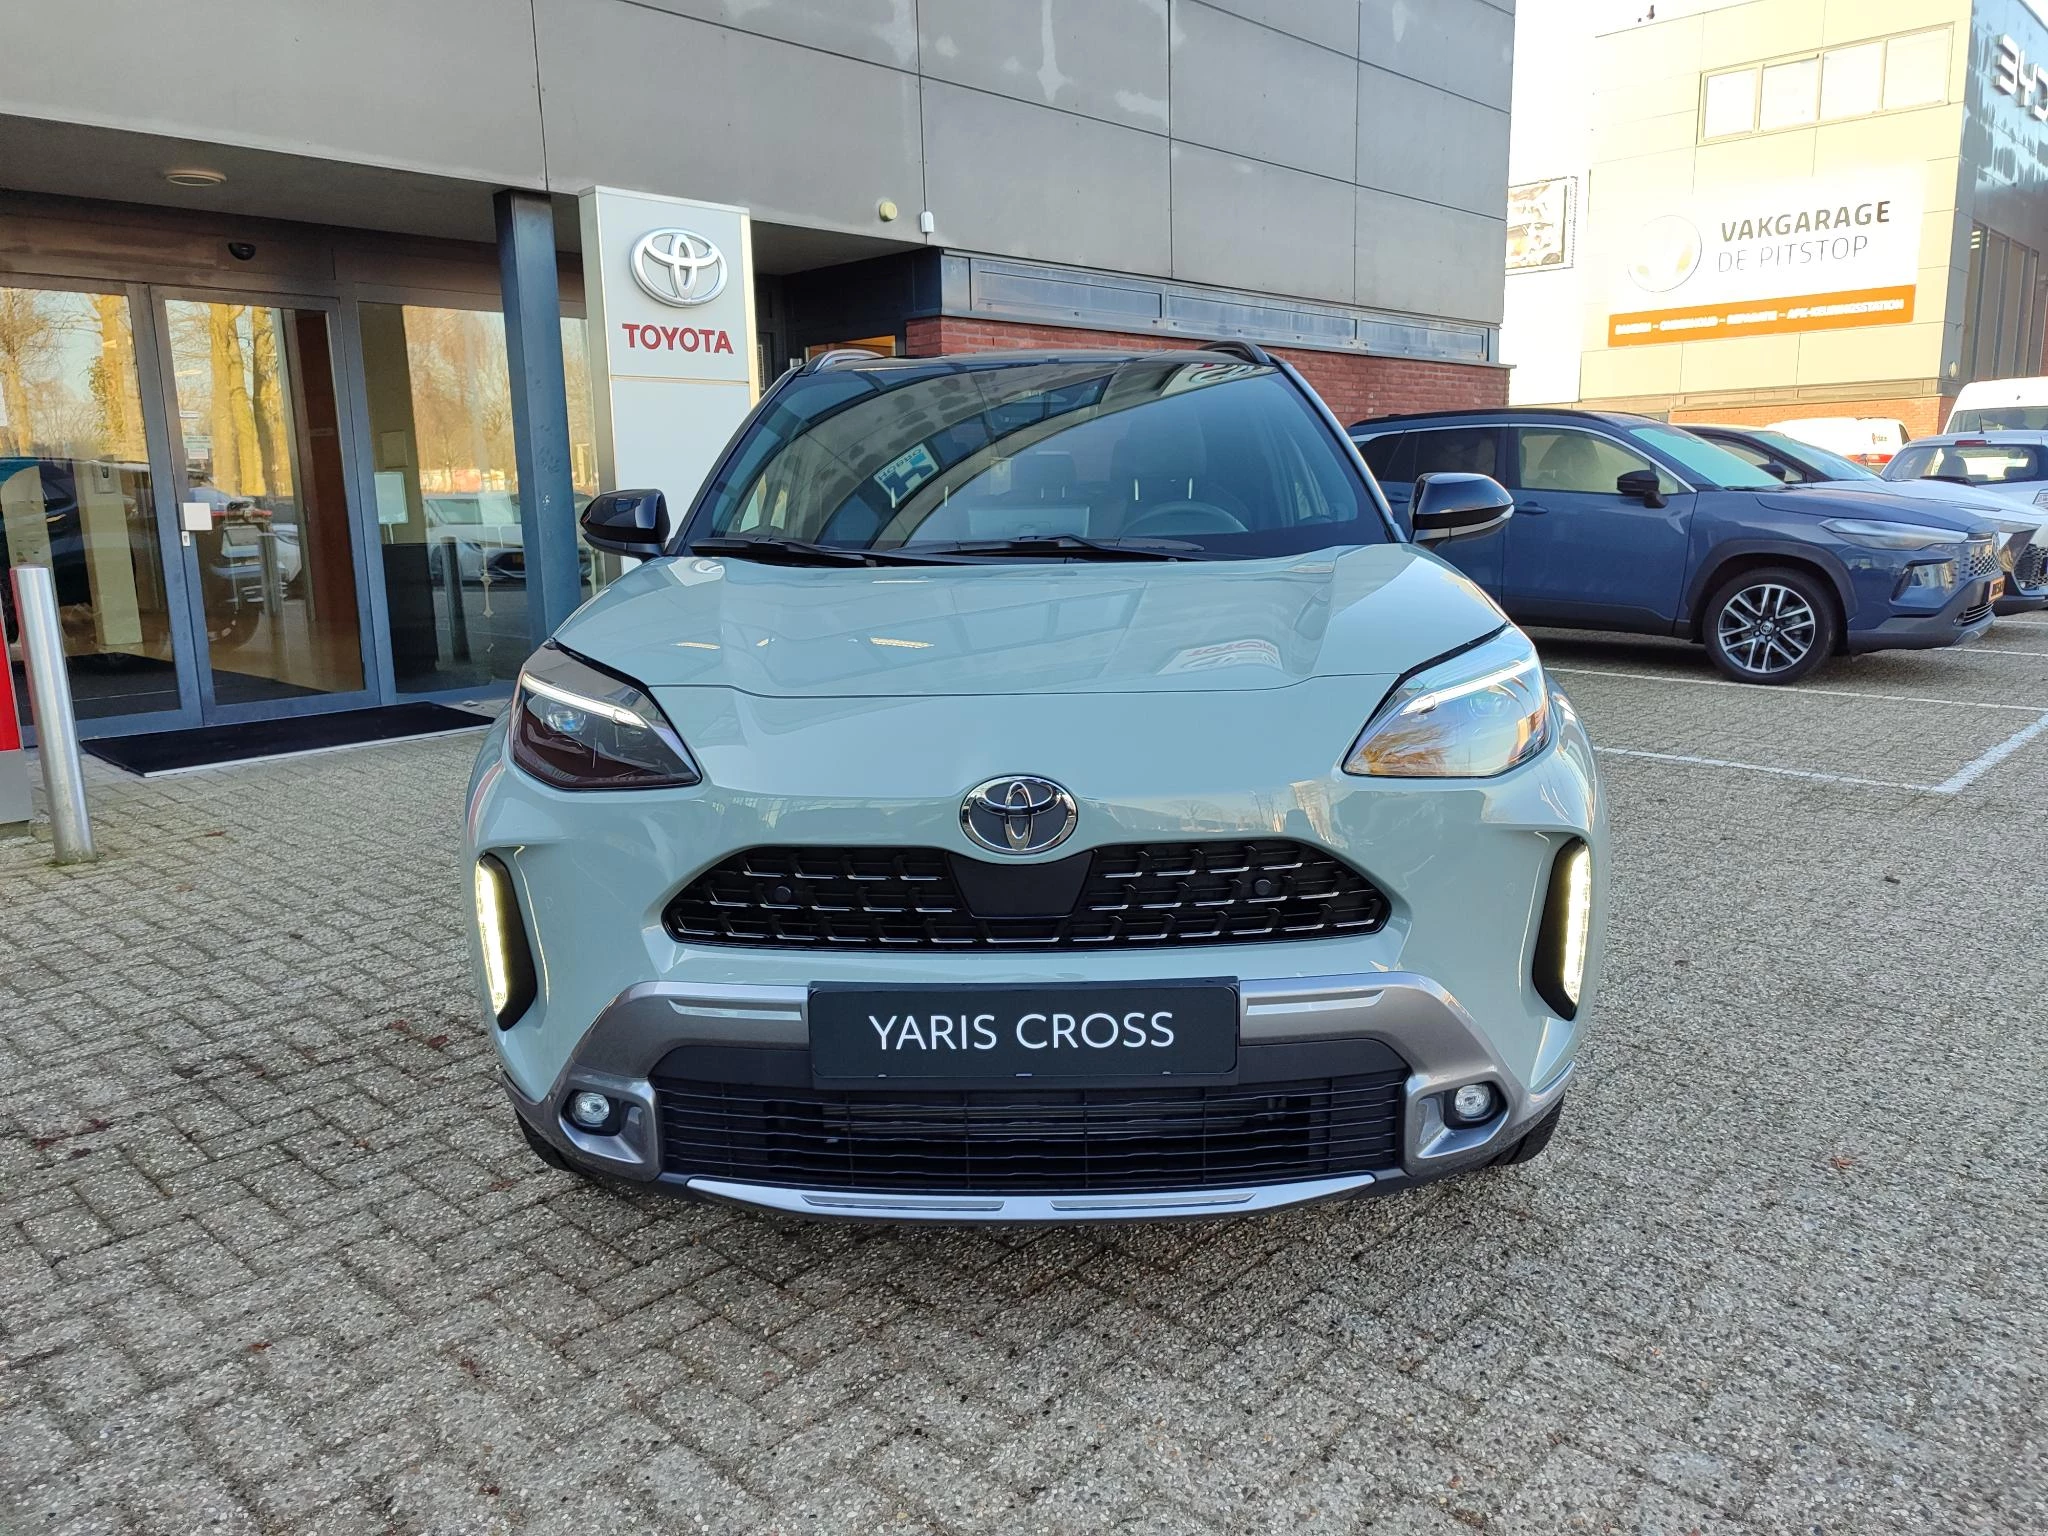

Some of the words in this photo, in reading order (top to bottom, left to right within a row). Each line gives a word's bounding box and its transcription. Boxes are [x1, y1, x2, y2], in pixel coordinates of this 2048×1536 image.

[1721, 200, 1891, 242] VAKGARAGE
[1718, 249, 1749, 273] DE
[1759, 235, 1868, 268] PITSTOP
[621, 323, 735, 355] TOYOTA
[868, 1014, 997, 1050] YARIS
[1016, 1011, 1175, 1049] CROSS
